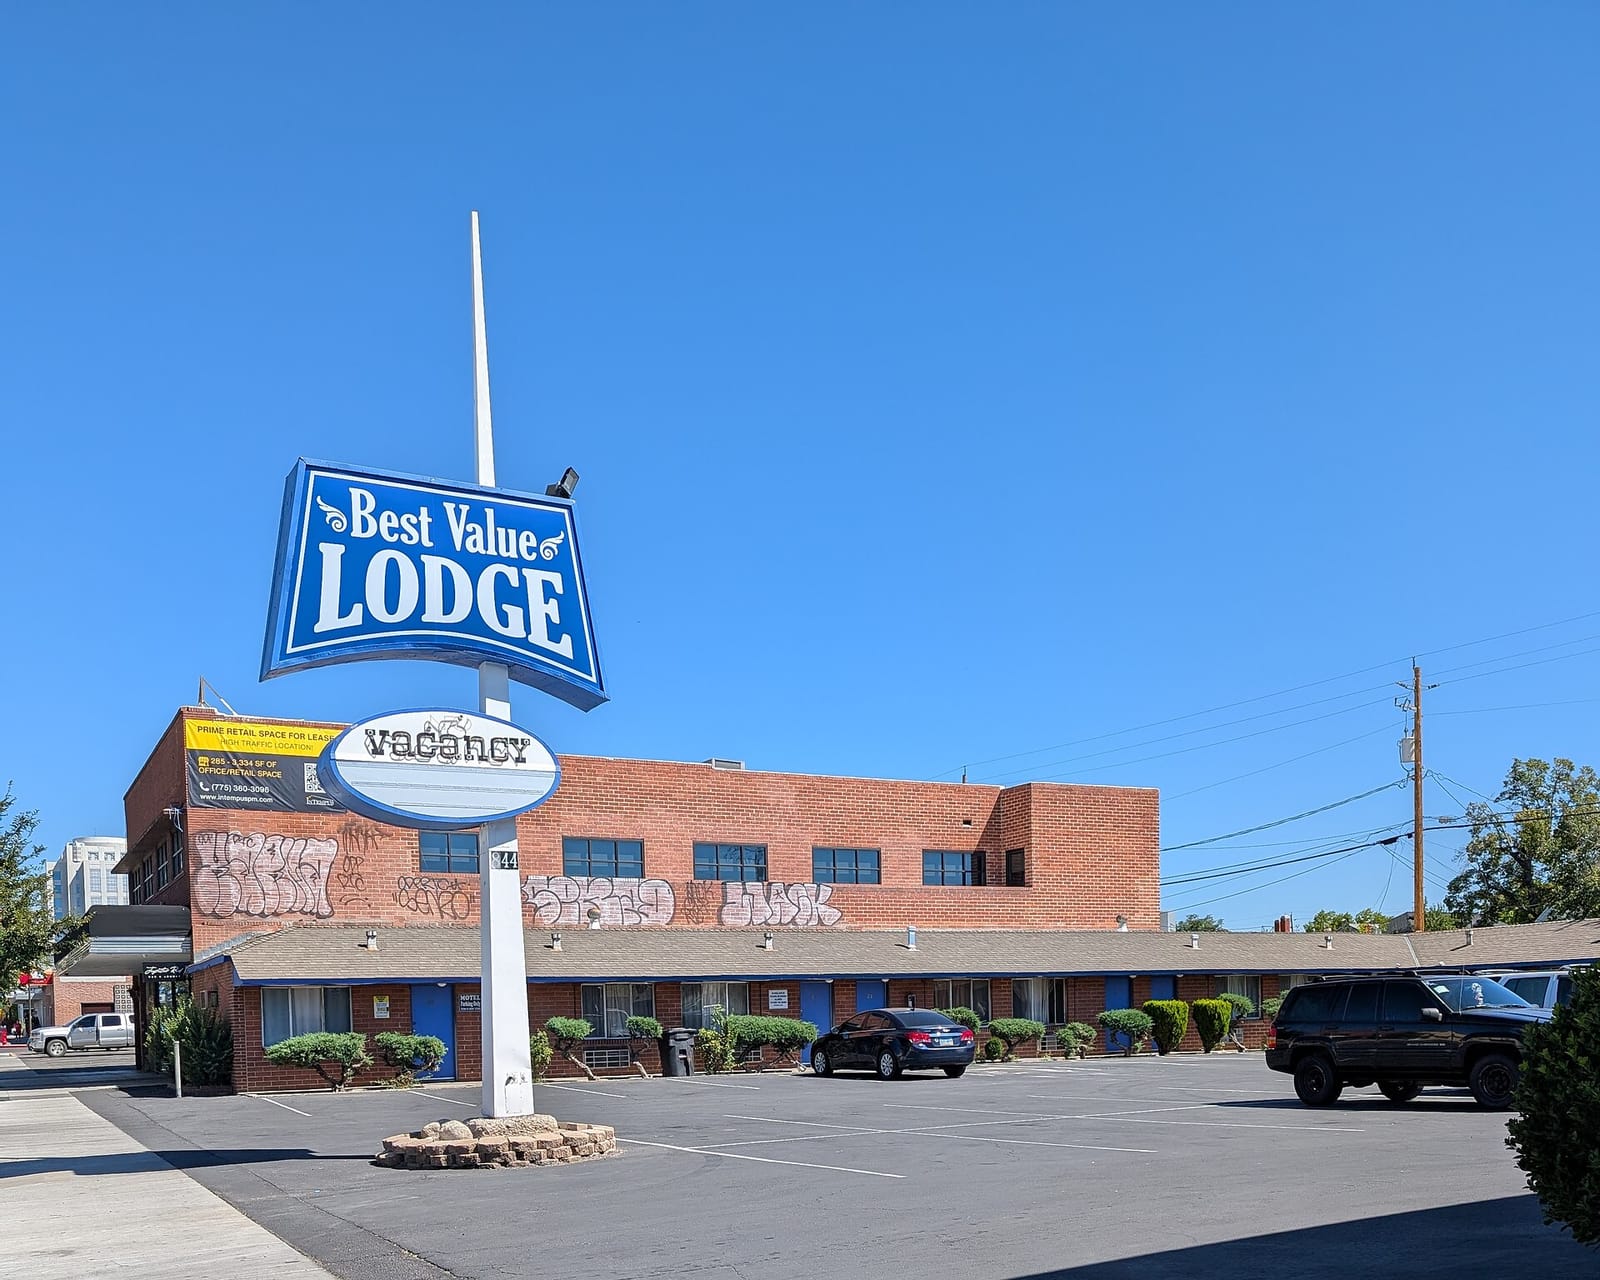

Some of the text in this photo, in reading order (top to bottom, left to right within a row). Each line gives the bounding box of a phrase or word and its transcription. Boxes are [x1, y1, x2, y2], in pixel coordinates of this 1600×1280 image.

[349, 487, 537, 561] Best Value
[313, 542, 574, 660] LODGE
[197, 725, 225, 735] PRIME
[227, 727, 257, 738] RETAIL
[258, 730, 287, 740] SPACE
[288, 732, 306, 741] FOR
[220, 738, 240, 746] HIGH
[241, 739, 273, 749] TRAFFIC
[198, 767, 282, 779] OFFICE/RETAIL SPACE
